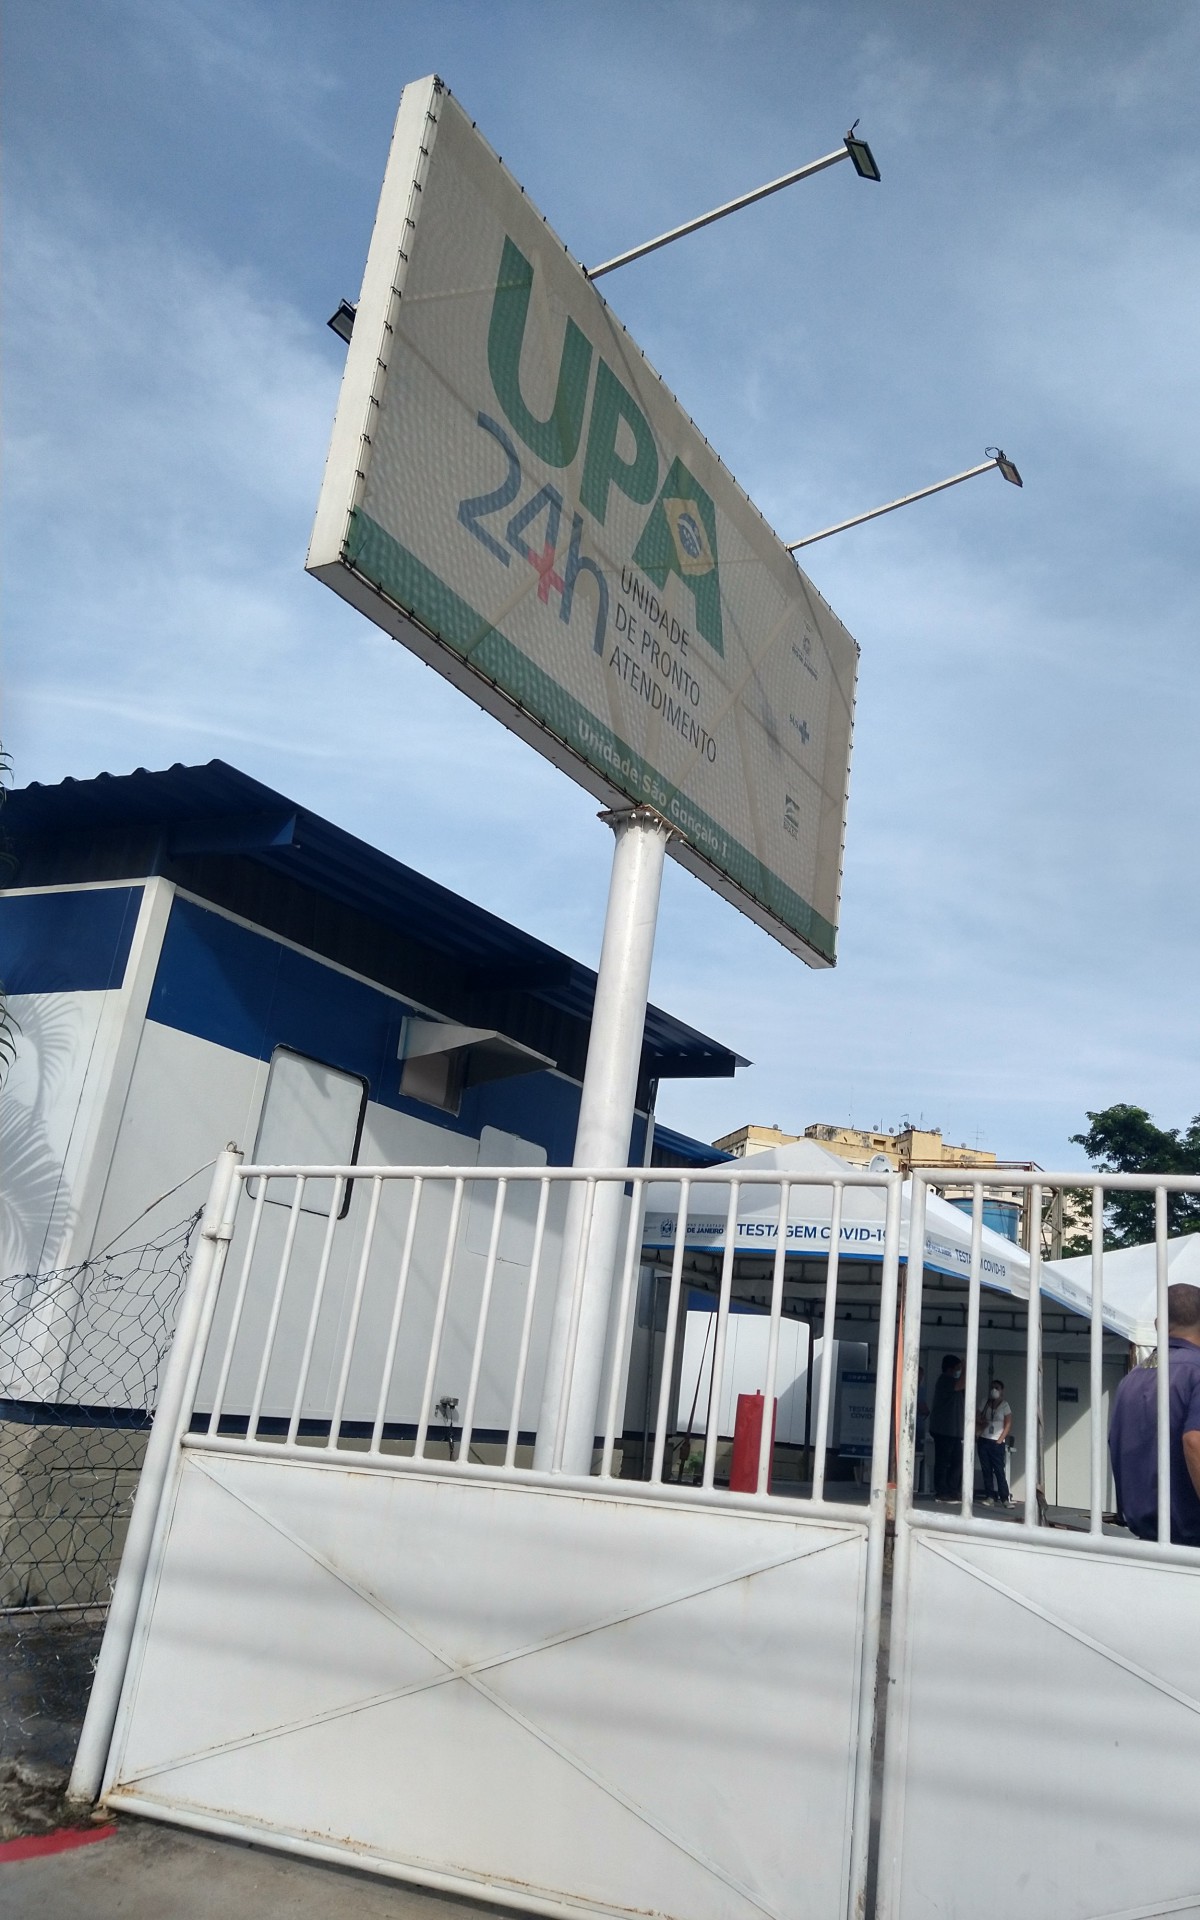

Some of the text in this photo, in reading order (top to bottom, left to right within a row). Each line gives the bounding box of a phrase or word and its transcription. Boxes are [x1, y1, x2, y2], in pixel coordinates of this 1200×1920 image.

[488, 234, 724, 659] UPA
[457, 410, 609, 658] 24h
[615, 603, 700, 707] DE PRONTO
[621, 565, 690, 657] UNIDADE
[609, 645, 717, 763] ATENDIMENTO
[578, 718, 638, 786] Unidade
[642, 774, 667, 807] São
[671, 797, 719, 851] Gonçalo
[696, 1227, 724, 1235] JANEIRO
[820, 1226, 886, 1242] CVID-1
[848, 1405, 875, 1413] TESTAG
[850, 1412, 875, 1420] COVID-
